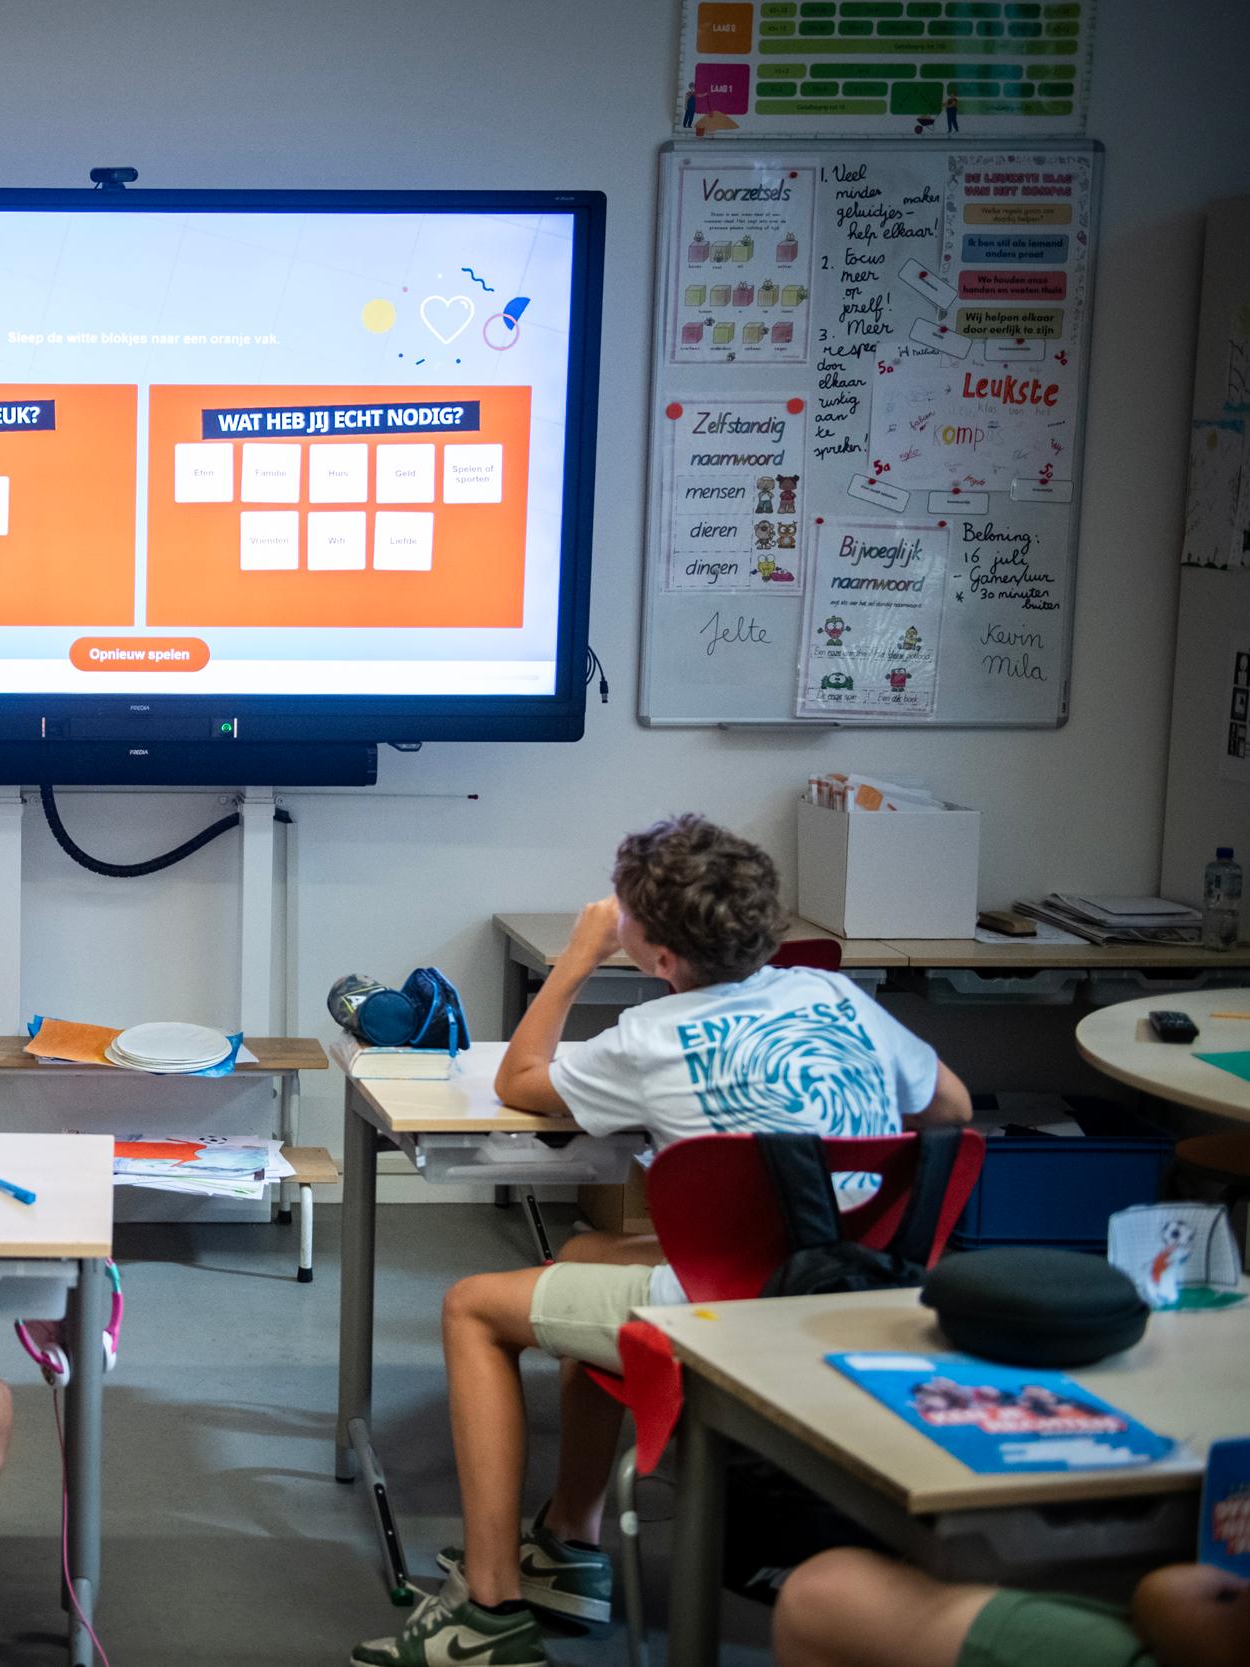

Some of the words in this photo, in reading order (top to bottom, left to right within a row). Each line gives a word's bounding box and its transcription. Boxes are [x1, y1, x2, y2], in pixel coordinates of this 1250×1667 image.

[832, 163, 868, 183] Veel
[703, 178, 792, 202] Voorzetsels
[968, 239, 976, 248] Ik
[978, 239, 995, 248] ben
[996, 239, 1010, 248] stil
[1012, 239, 1026, 248] als
[1028, 239, 1063, 248] iemand
[845, 248, 886, 266] Focus
[985, 249, 1017, 258] anders
[1018, 250, 1044, 260] praat
[840, 269, 879, 283] meer
[993, 275, 1026, 283] houden
[965, 312, 983, 324] Wij
[985, 312, 1019, 324] helpen
[1021, 312, 1055, 322] elkaar
[847, 319, 894, 336] Meer
[963, 324, 988, 334] door
[990, 324, 1022, 337] eerlijk
[1023, 325, 1034, 334] te
[1036, 325, 1054, 337] zijn
[7, 331, 45, 347] Sleep
[47, 332, 63, 344] de
[66, 332, 99, 345] witte
[101, 331, 148, 348] blokjes
[151, 335, 180, 345] naar
[183, 335, 207, 345] een
[210, 334, 251, 348] oranje
[254, 333, 281, 345] vak.
[817, 358, 846, 371] door
[818, 372, 867, 389] elkaar
[963, 373, 1060, 407] Leukste
[818, 391, 860, 415] rustig
[217, 413, 263, 432] WAT
[266, 411, 305, 430] HEB
[306, 411, 330, 434] JIJ
[334, 409, 383, 428] ECHT
[387, 406, 465, 427] NODIG?
[815, 413, 849, 423] aan
[692, 412, 786, 443] Zelfstandig
[815, 426, 835, 438] te
[690, 450, 785, 466] naamwoord
[194, 469, 215, 477] Eten
[395, 469, 416, 477] Geld
[452, 465, 482, 474] Spelen
[484, 465, 494, 473] of
[455, 476, 490, 484] sporten
[685, 486, 746, 499] mensen
[690, 521, 738, 538] dieren
[839, 535, 923, 569] Bijvoeglijk
[964, 547, 980, 563] 16
[685, 559, 738, 584] dingen
[831, 576, 925, 592] naamwoord
[980, 588, 995, 600] 30
[699, 611, 772, 656] Jelte
[980, 623, 1044, 649] Kevin
[89, 648, 146, 662] Opnieuw
[148, 648, 190, 662] spelen
[983, 652, 1047, 682] Mila
